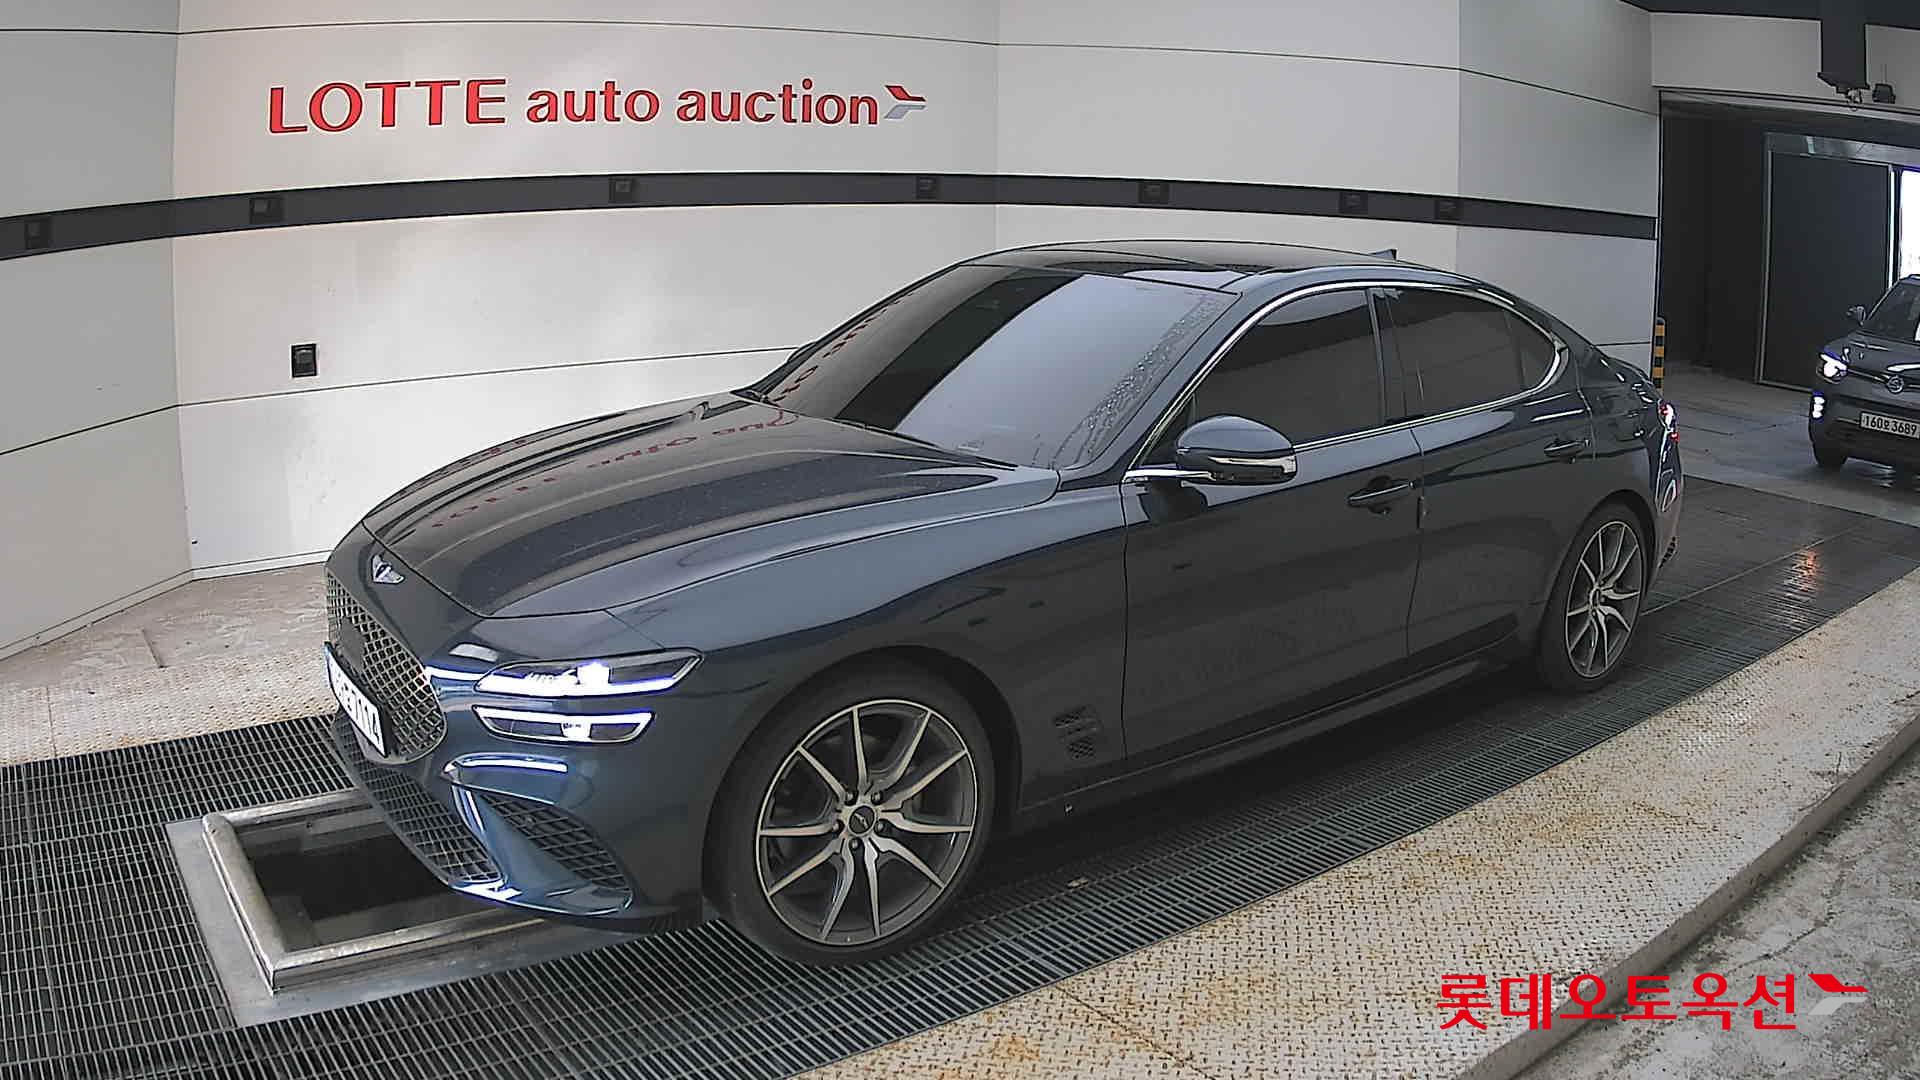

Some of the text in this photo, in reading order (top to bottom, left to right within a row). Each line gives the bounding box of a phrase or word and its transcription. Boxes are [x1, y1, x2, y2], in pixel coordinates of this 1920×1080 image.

[268, 78, 878, 134] LOTTE auto auction
